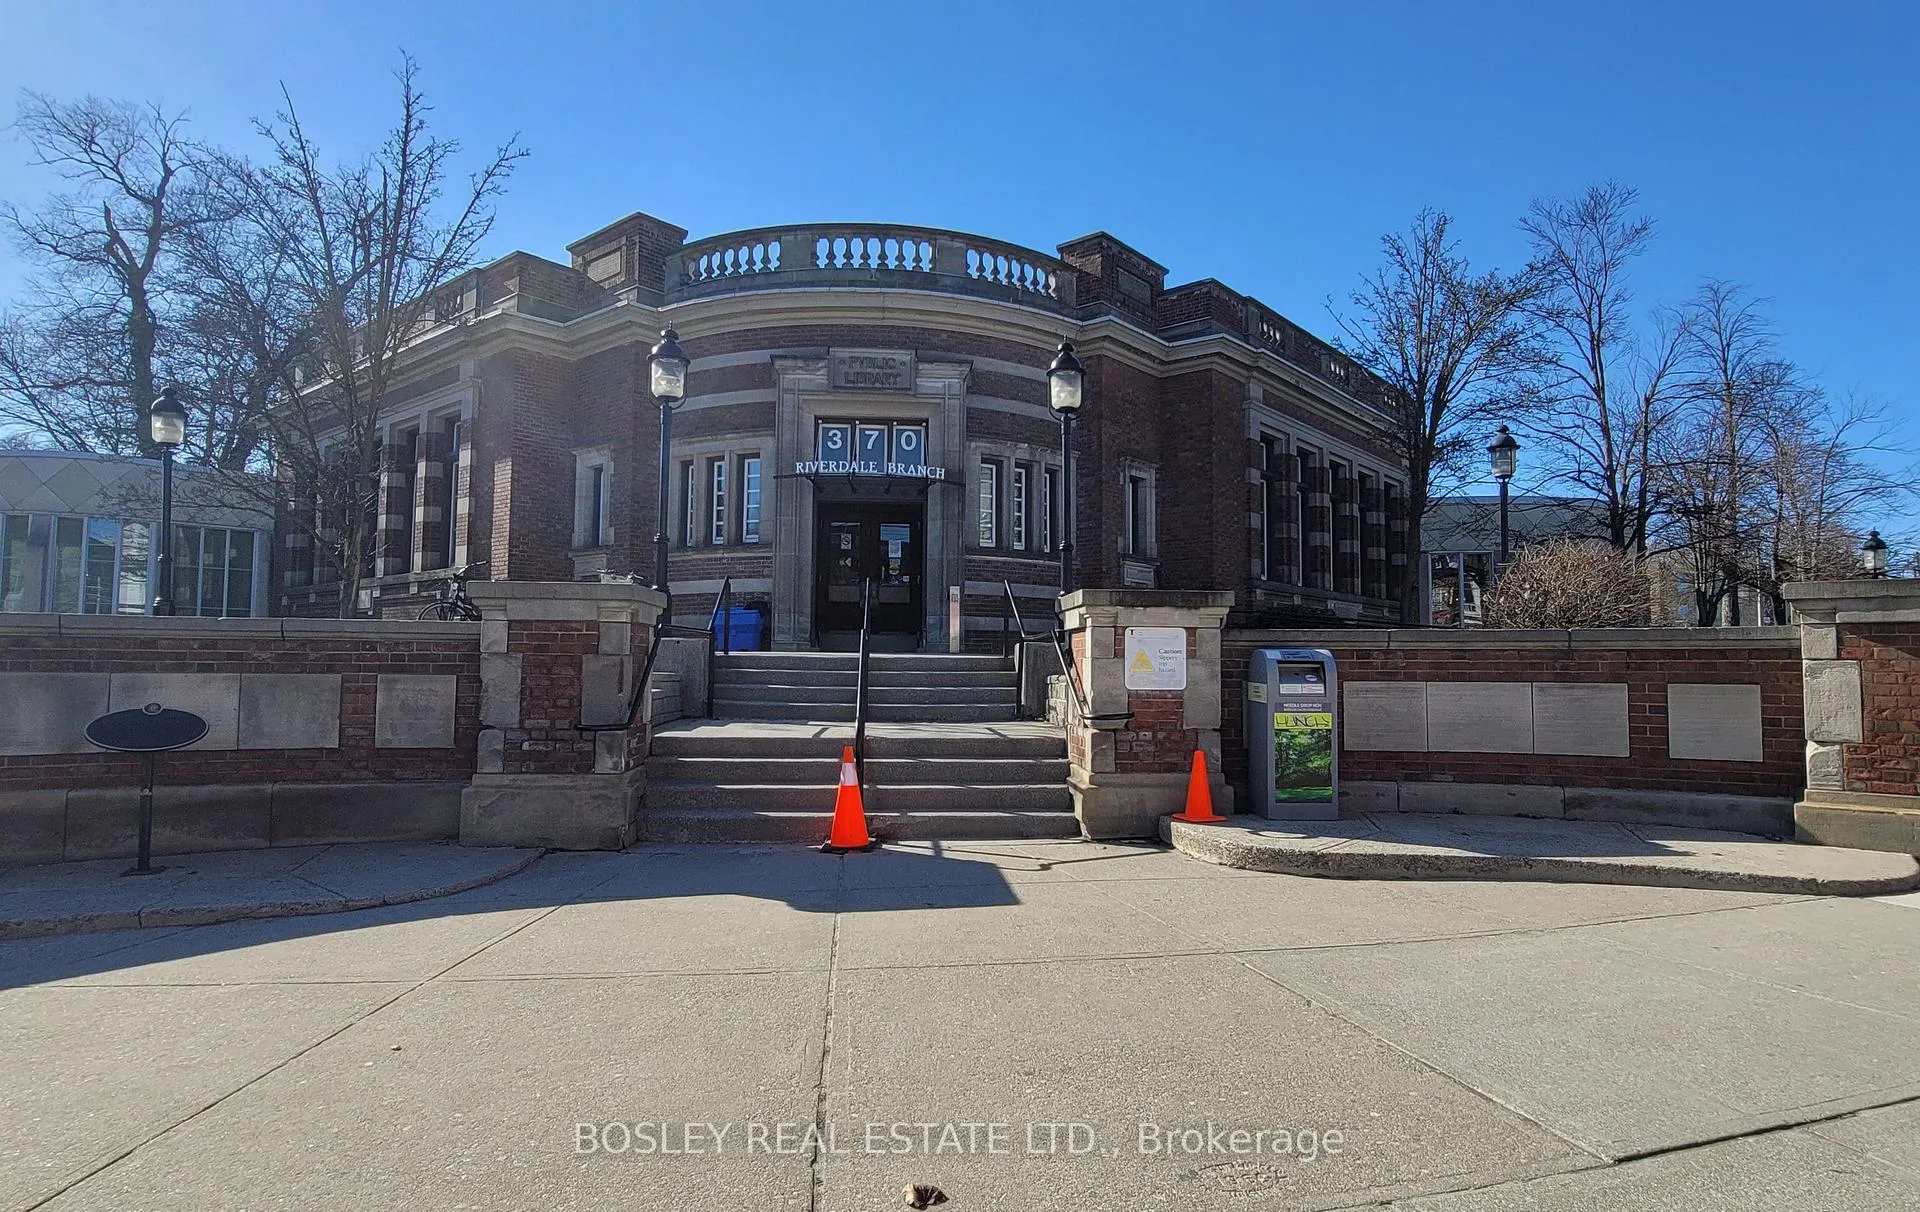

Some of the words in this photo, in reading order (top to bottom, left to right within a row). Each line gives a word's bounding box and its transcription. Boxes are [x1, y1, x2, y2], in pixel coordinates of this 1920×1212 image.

[843, 371, 901, 385] LIBRARY
[795, 461, 878, 474] RIVERDALE
[887, 462, 946, 480] BRANCH
